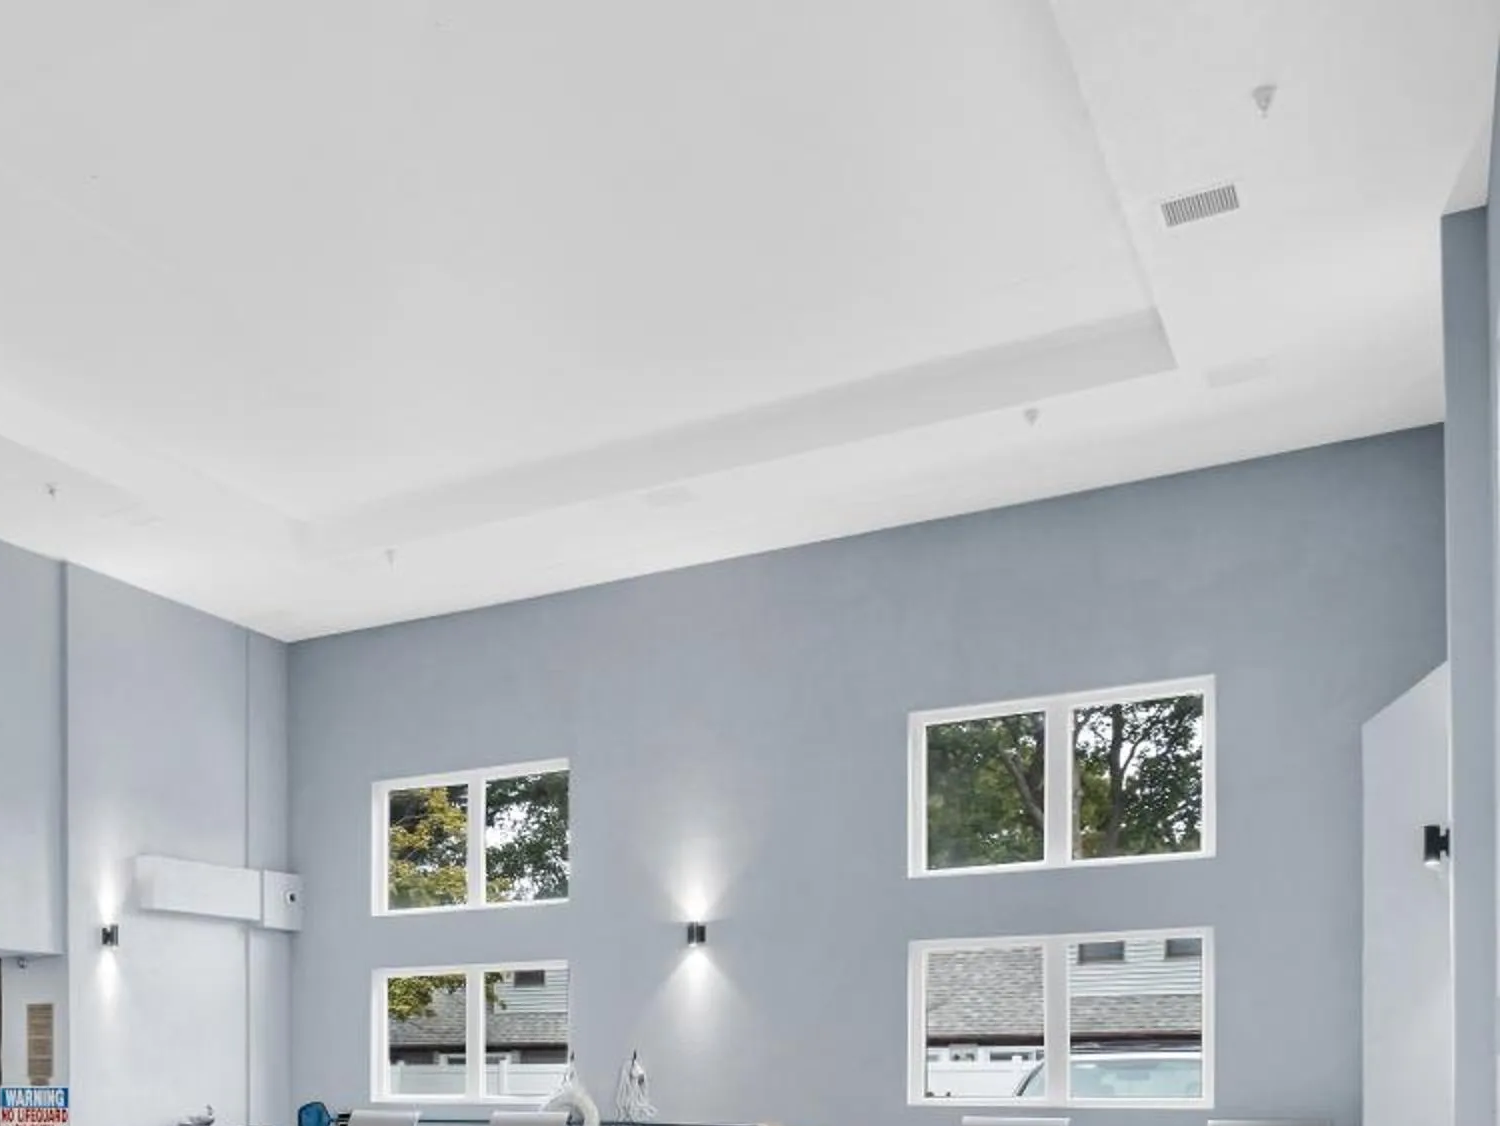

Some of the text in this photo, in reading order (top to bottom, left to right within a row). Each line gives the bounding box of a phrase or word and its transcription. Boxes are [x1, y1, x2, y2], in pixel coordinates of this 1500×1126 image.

[5, 1089, 65, 1107] WARNING
[2, 1108, 68, 1123] NO LIFEGUARD
